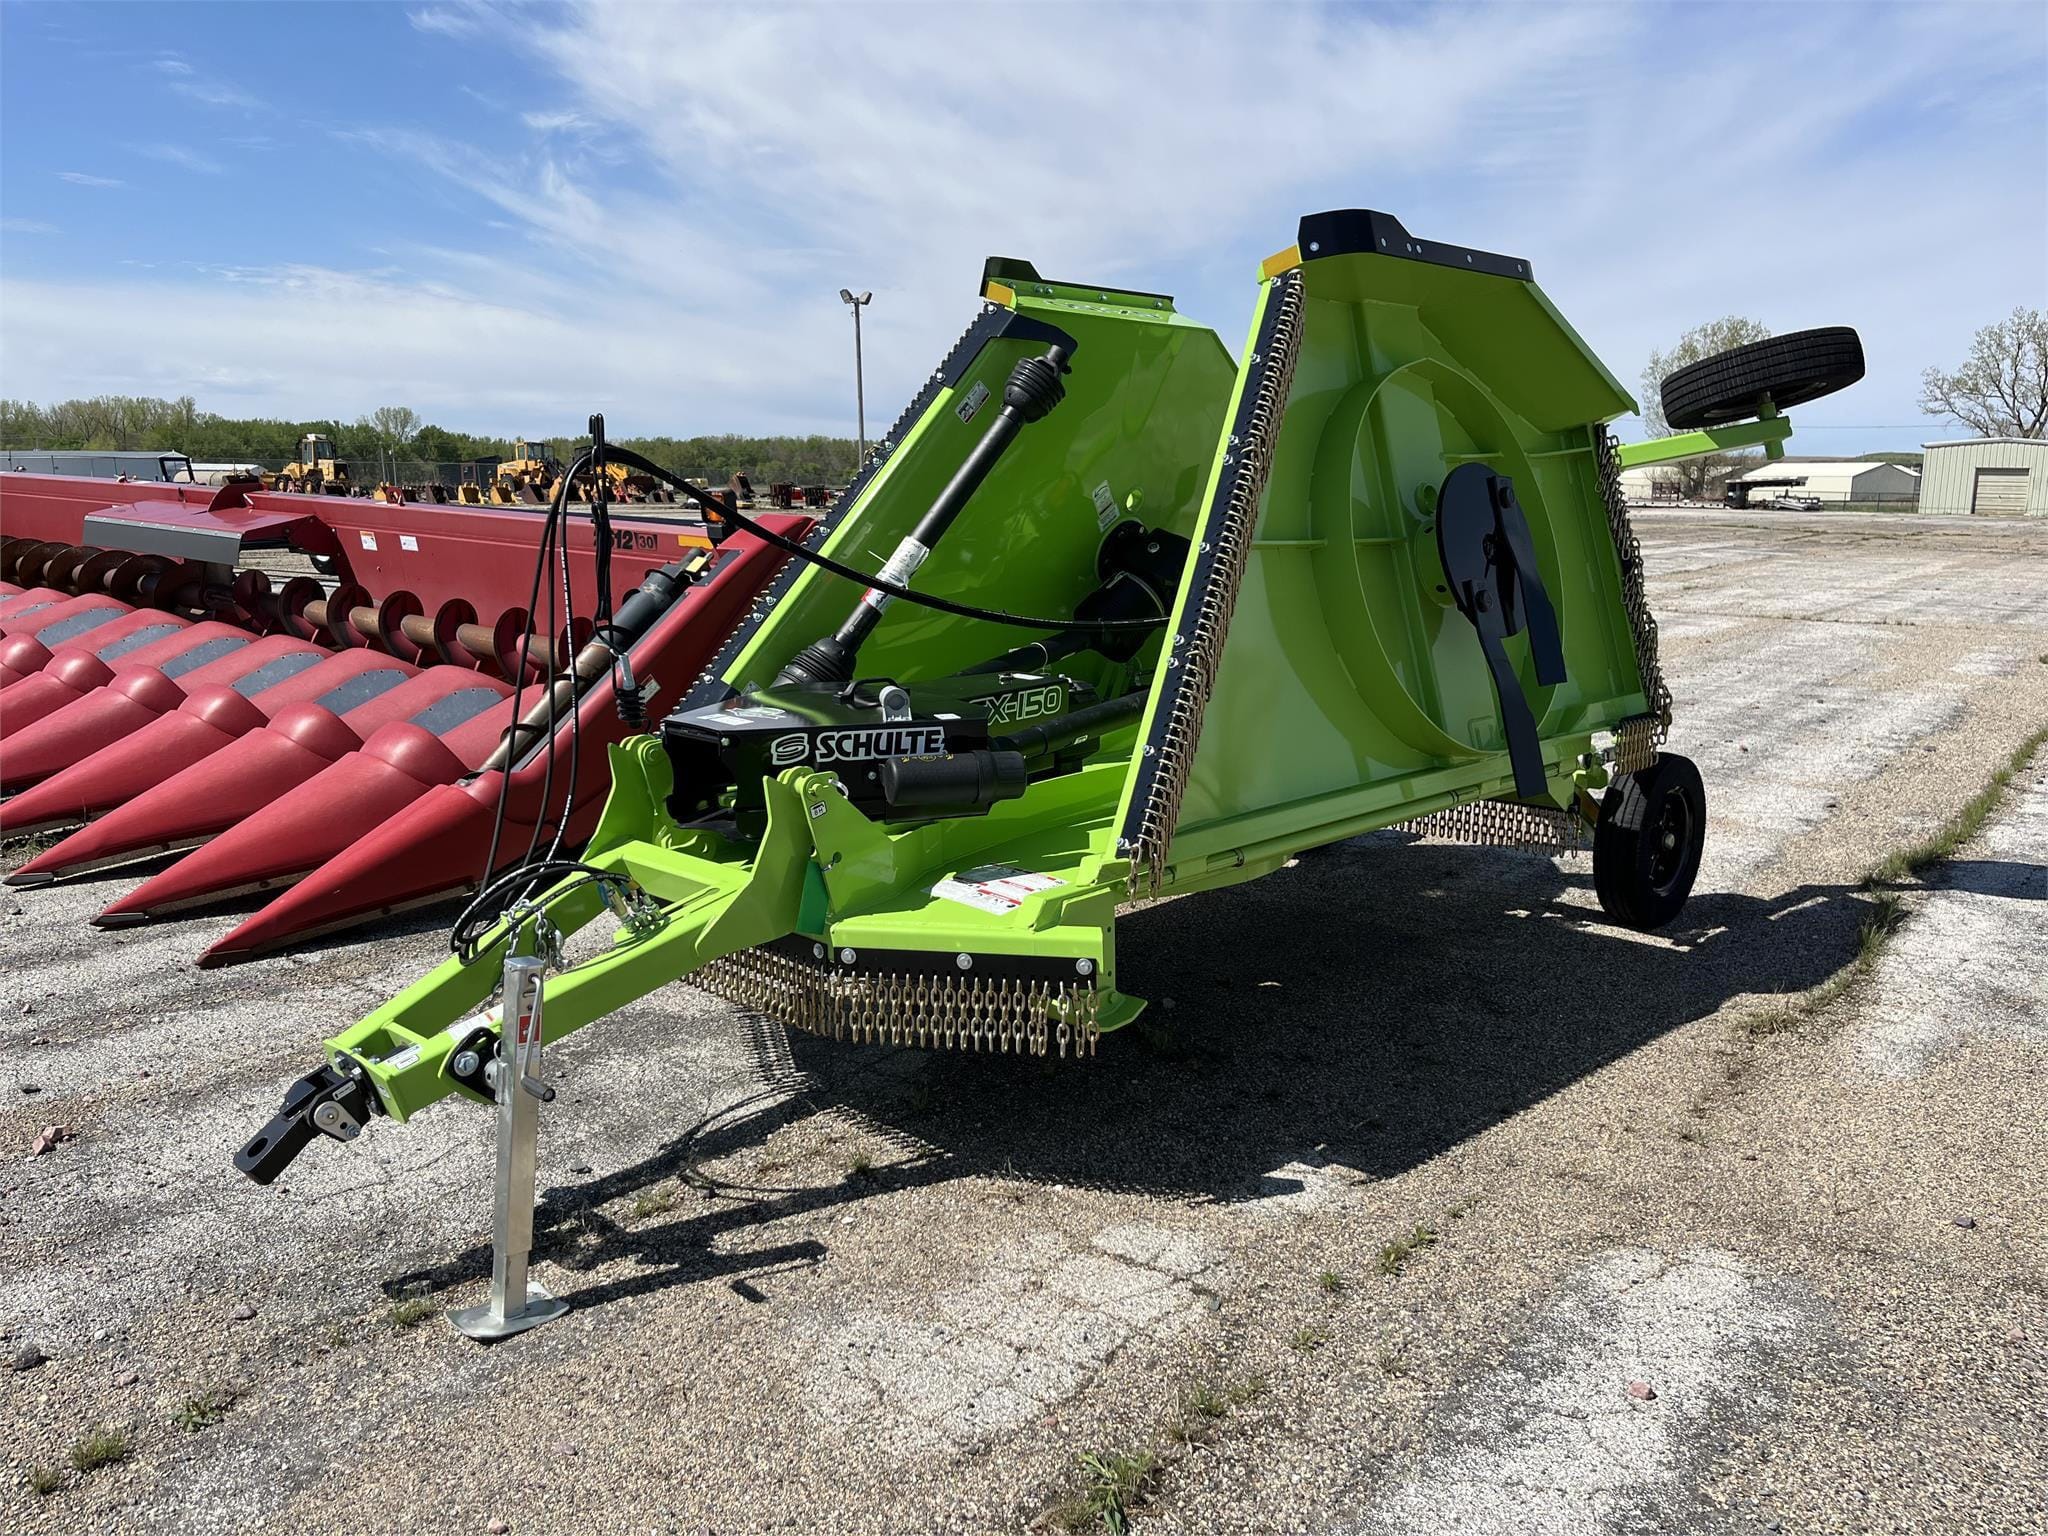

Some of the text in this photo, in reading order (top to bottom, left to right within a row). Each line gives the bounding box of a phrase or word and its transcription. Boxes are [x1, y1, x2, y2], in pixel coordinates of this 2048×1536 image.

[639, 534, 654, 549] 30
[971, 685, 1062, 726] X-150
[816, 727, 945, 762] SCHULTE
